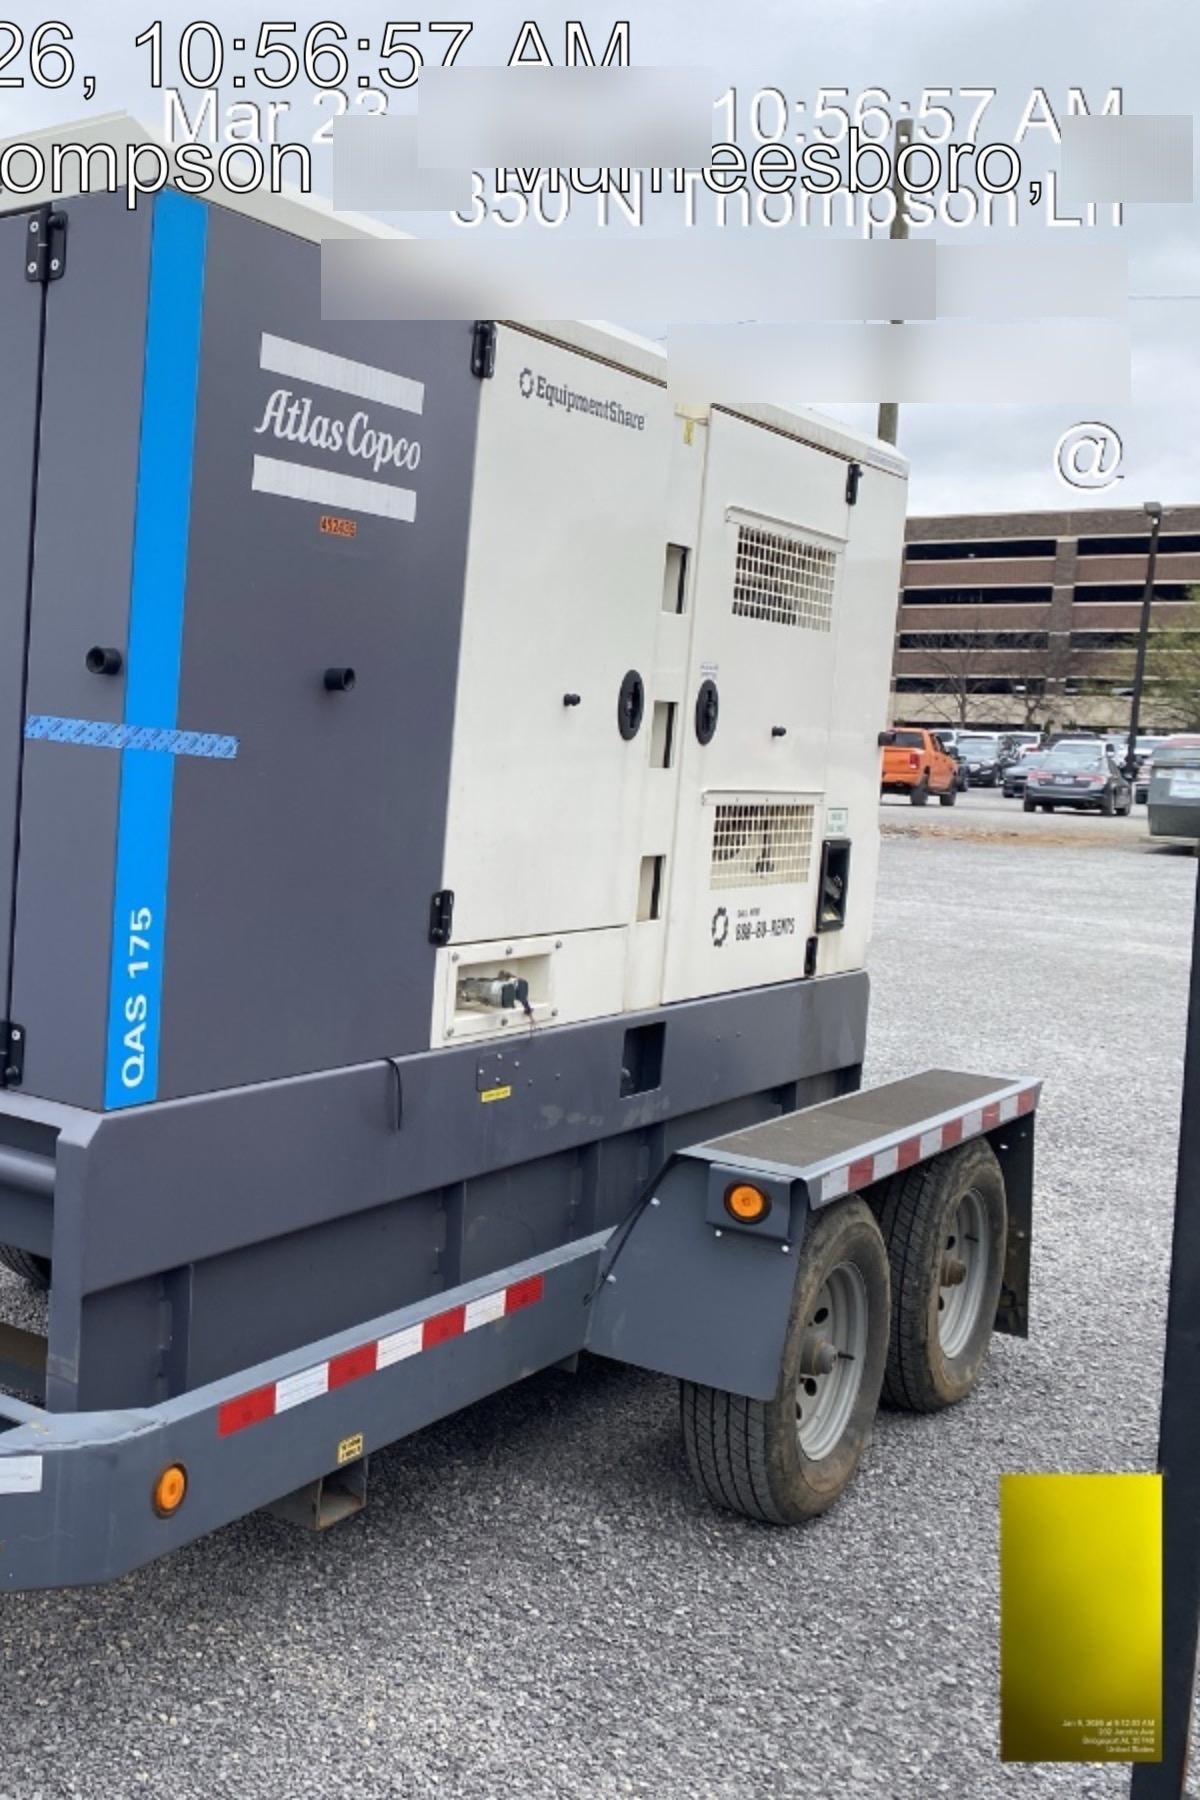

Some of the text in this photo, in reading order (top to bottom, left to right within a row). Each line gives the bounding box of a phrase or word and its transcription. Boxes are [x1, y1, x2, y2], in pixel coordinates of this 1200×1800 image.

[253, 388, 422, 473] Atlas Copco
[535, 375, 645, 431] EquipmentShare
[121, 907, 152, 1088] QAS 175
